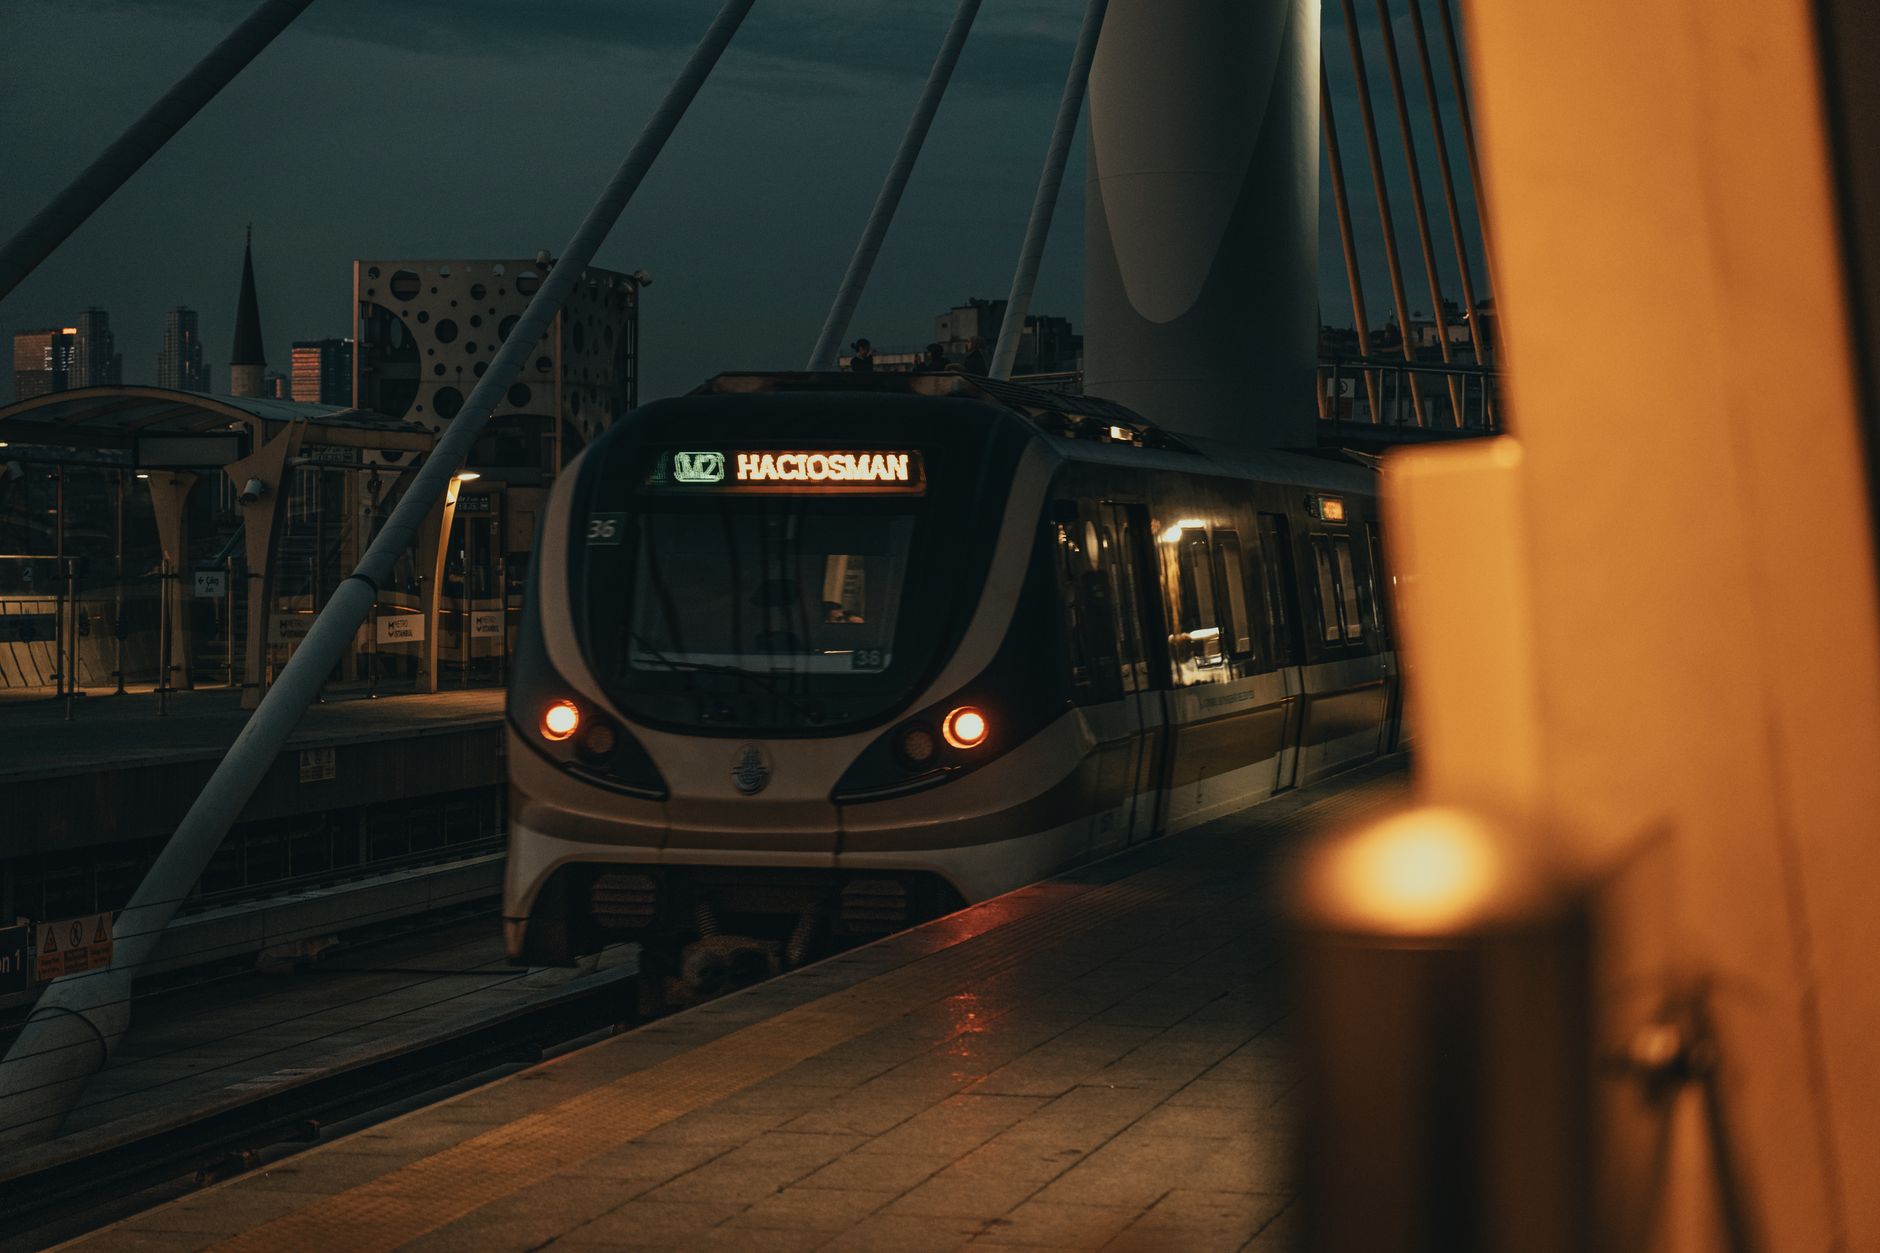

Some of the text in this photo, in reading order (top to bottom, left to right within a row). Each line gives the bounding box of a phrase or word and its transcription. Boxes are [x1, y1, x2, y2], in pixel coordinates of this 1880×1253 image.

[678, 453, 909, 480] M2 HACIOSMAN
[587, 519, 617, 538] 36
[856, 649, 880, 666] 36
[14, 948, 21, 971] 1
